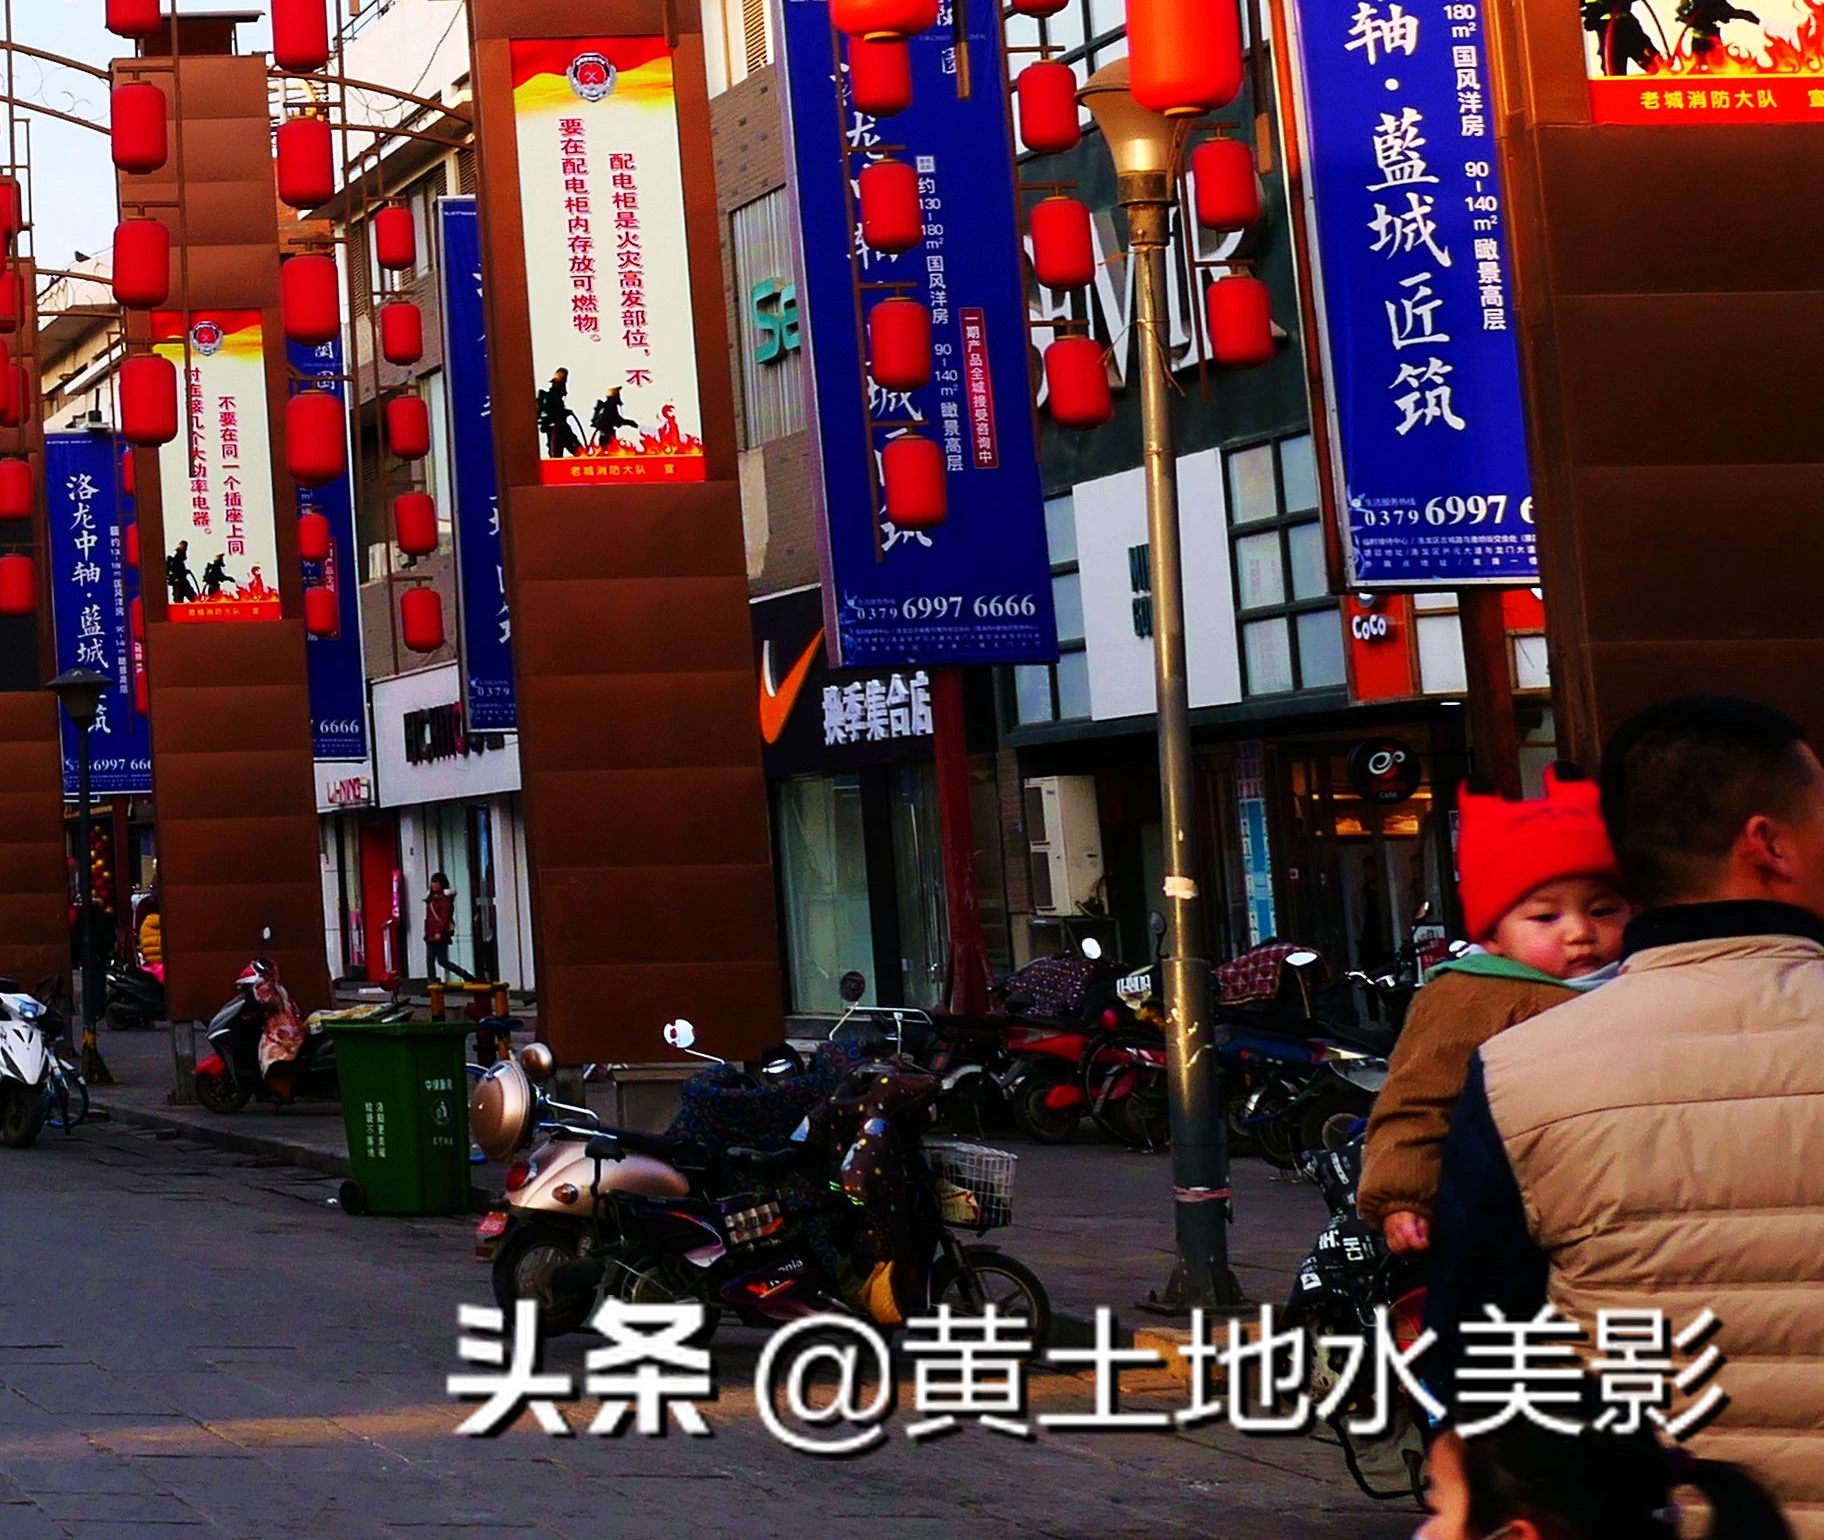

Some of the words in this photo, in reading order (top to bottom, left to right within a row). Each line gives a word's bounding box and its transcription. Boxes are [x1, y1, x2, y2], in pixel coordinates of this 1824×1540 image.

[1640, 90, 1777, 110] 老城消防大队
[559, 118, 602, 343] 要在配电柜内存放可燃物。
[609, 154, 652, 387] 配电柜是火灾高发部位，不
[219, 396, 245, 556] 不要在同一个插座上同
[570, 464, 646, 477] 老城消防大队
[1364, 510, 1420, 527] 0379
[1425, 495, 1508, 526] 6997
[902, 595, 962, 619] 6997
[973, 593, 1037, 618] 6666
